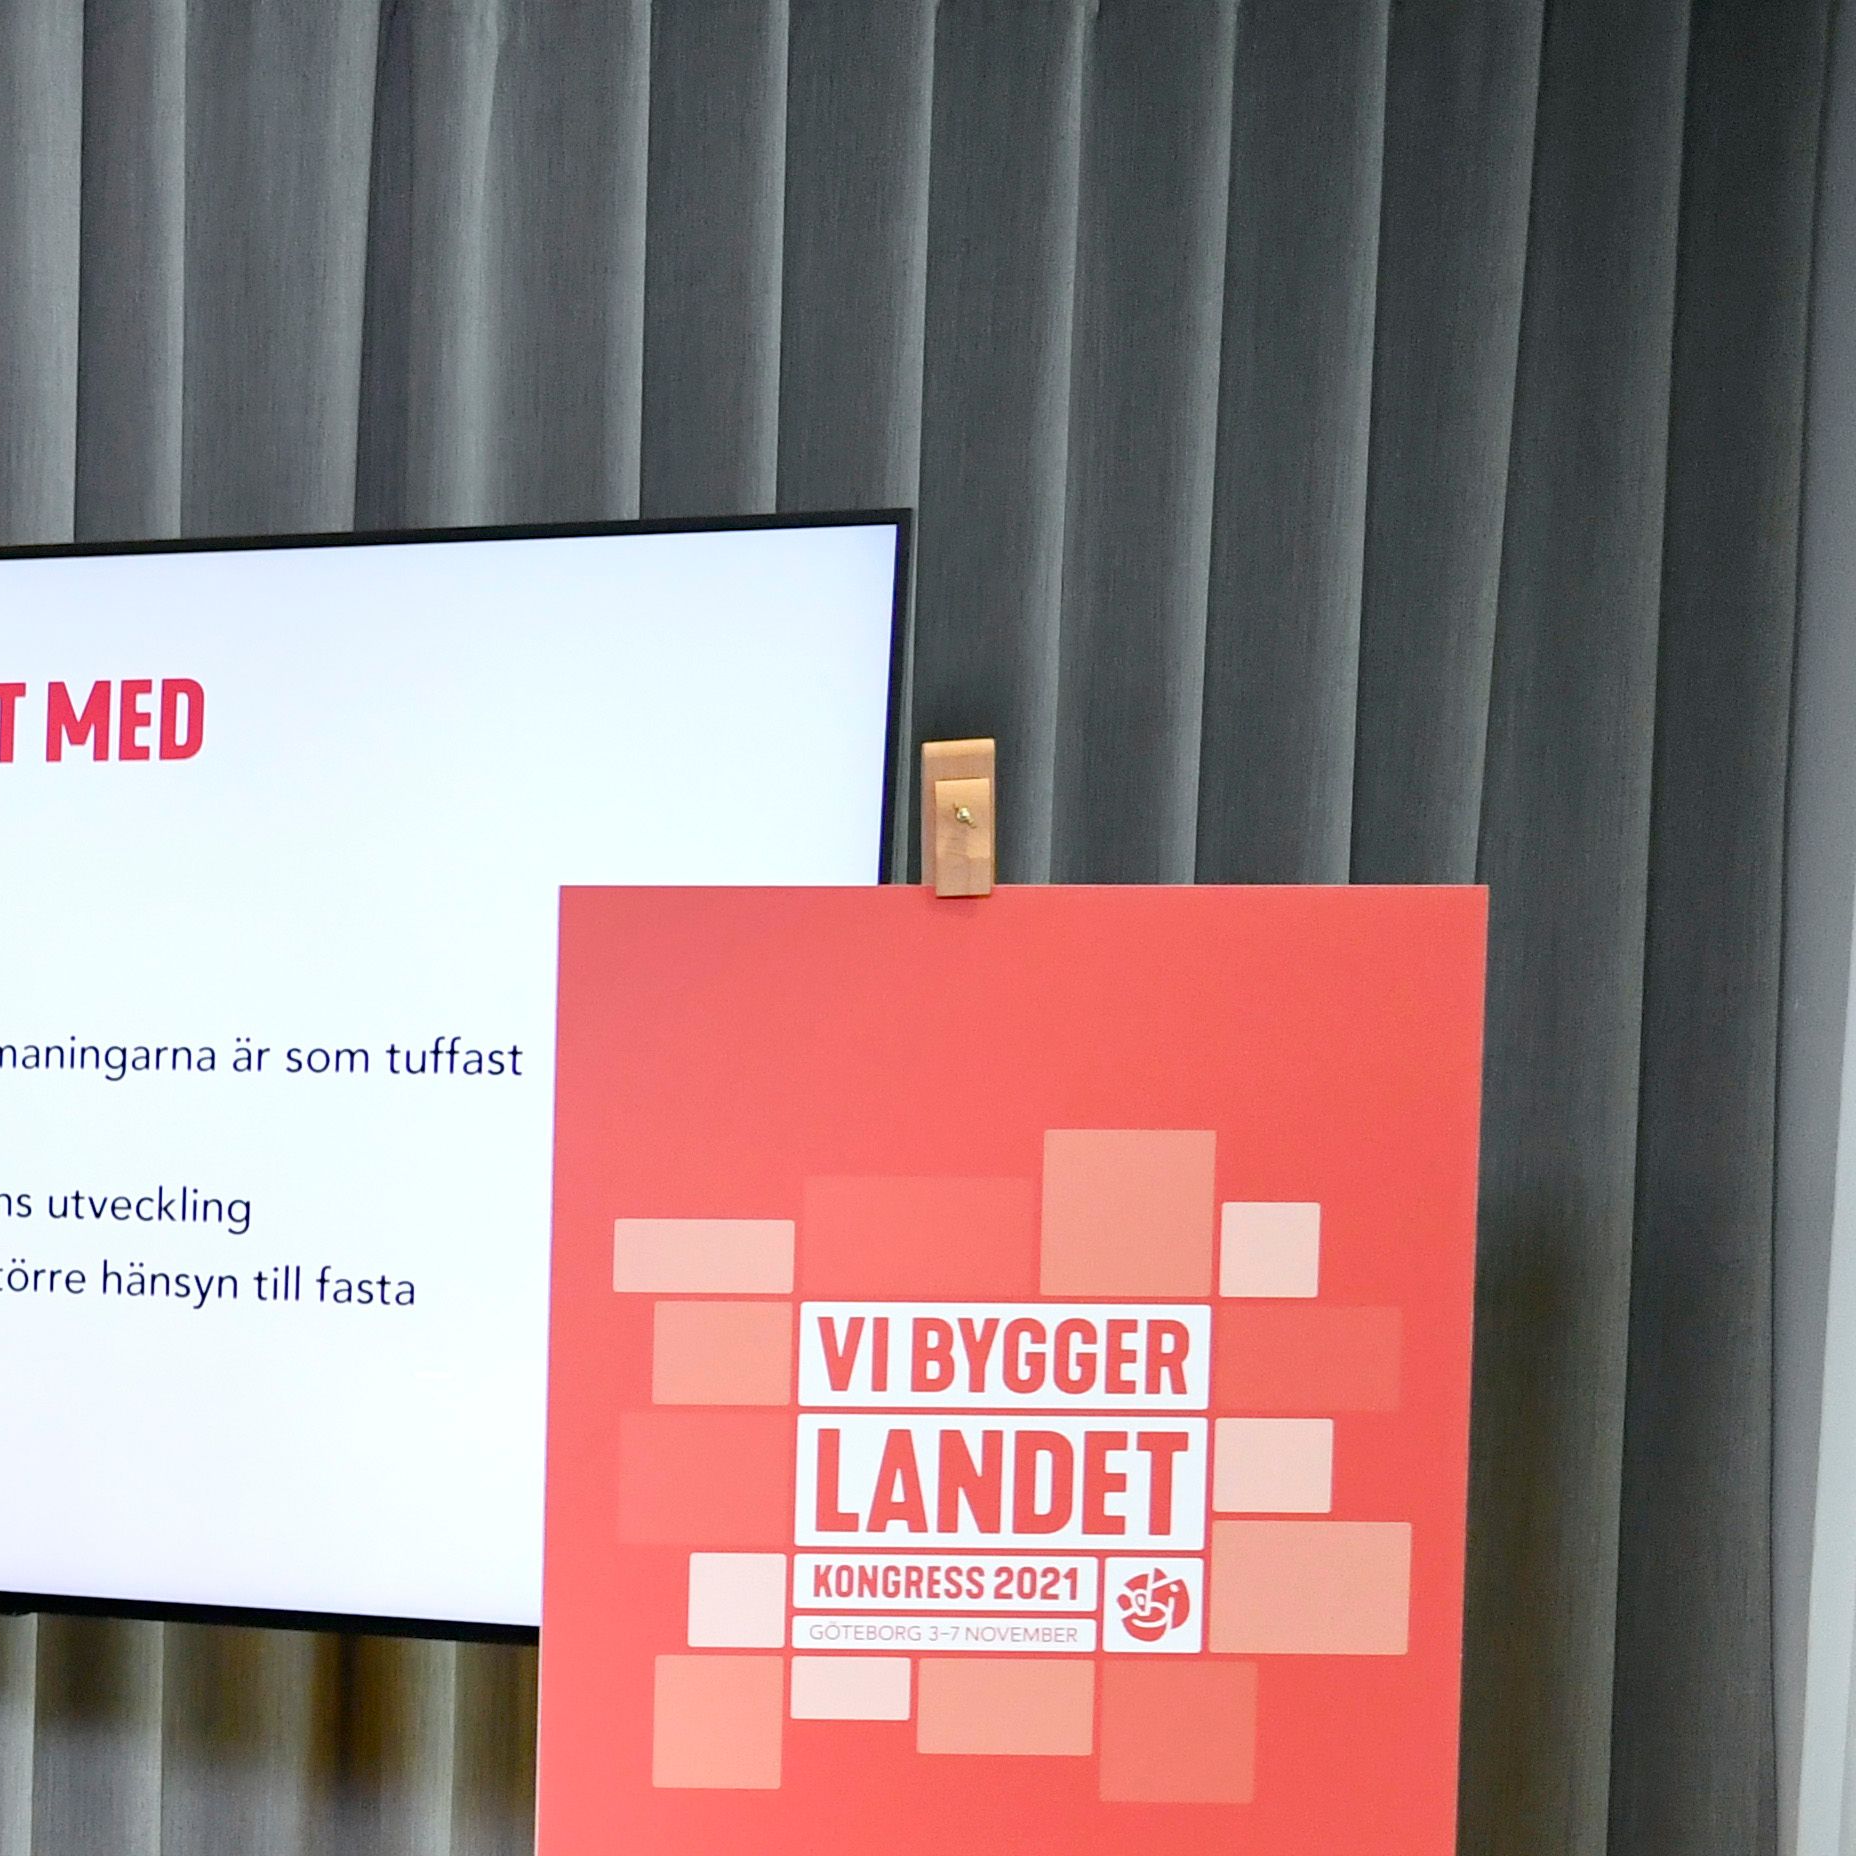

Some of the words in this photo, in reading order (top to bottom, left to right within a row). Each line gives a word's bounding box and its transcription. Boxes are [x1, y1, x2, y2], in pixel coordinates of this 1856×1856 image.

[46, 678, 204, 762] MED
[233, 1037, 270, 1072] är
[286, 1048, 369, 1073] som
[386, 1036, 523, 1075] tuffast
[49, 1185, 250, 1235] utveckling
[103, 1259, 237, 1309] hänsyn
[253, 1265, 300, 1301] till
[316, 1266, 414, 1305] fasta
[818, 1317, 888, 1391] VI
[911, 1318, 1189, 1394] BYGGER
[816, 1429, 1188, 1535] LANDET
[814, 1565, 984, 1599] KONGRESS
[994, 1567, 1077, 1600] 2021
[810, 1621, 921, 1641] GÖTEBORG
[966, 1627, 1077, 1642] NOVEMBER
